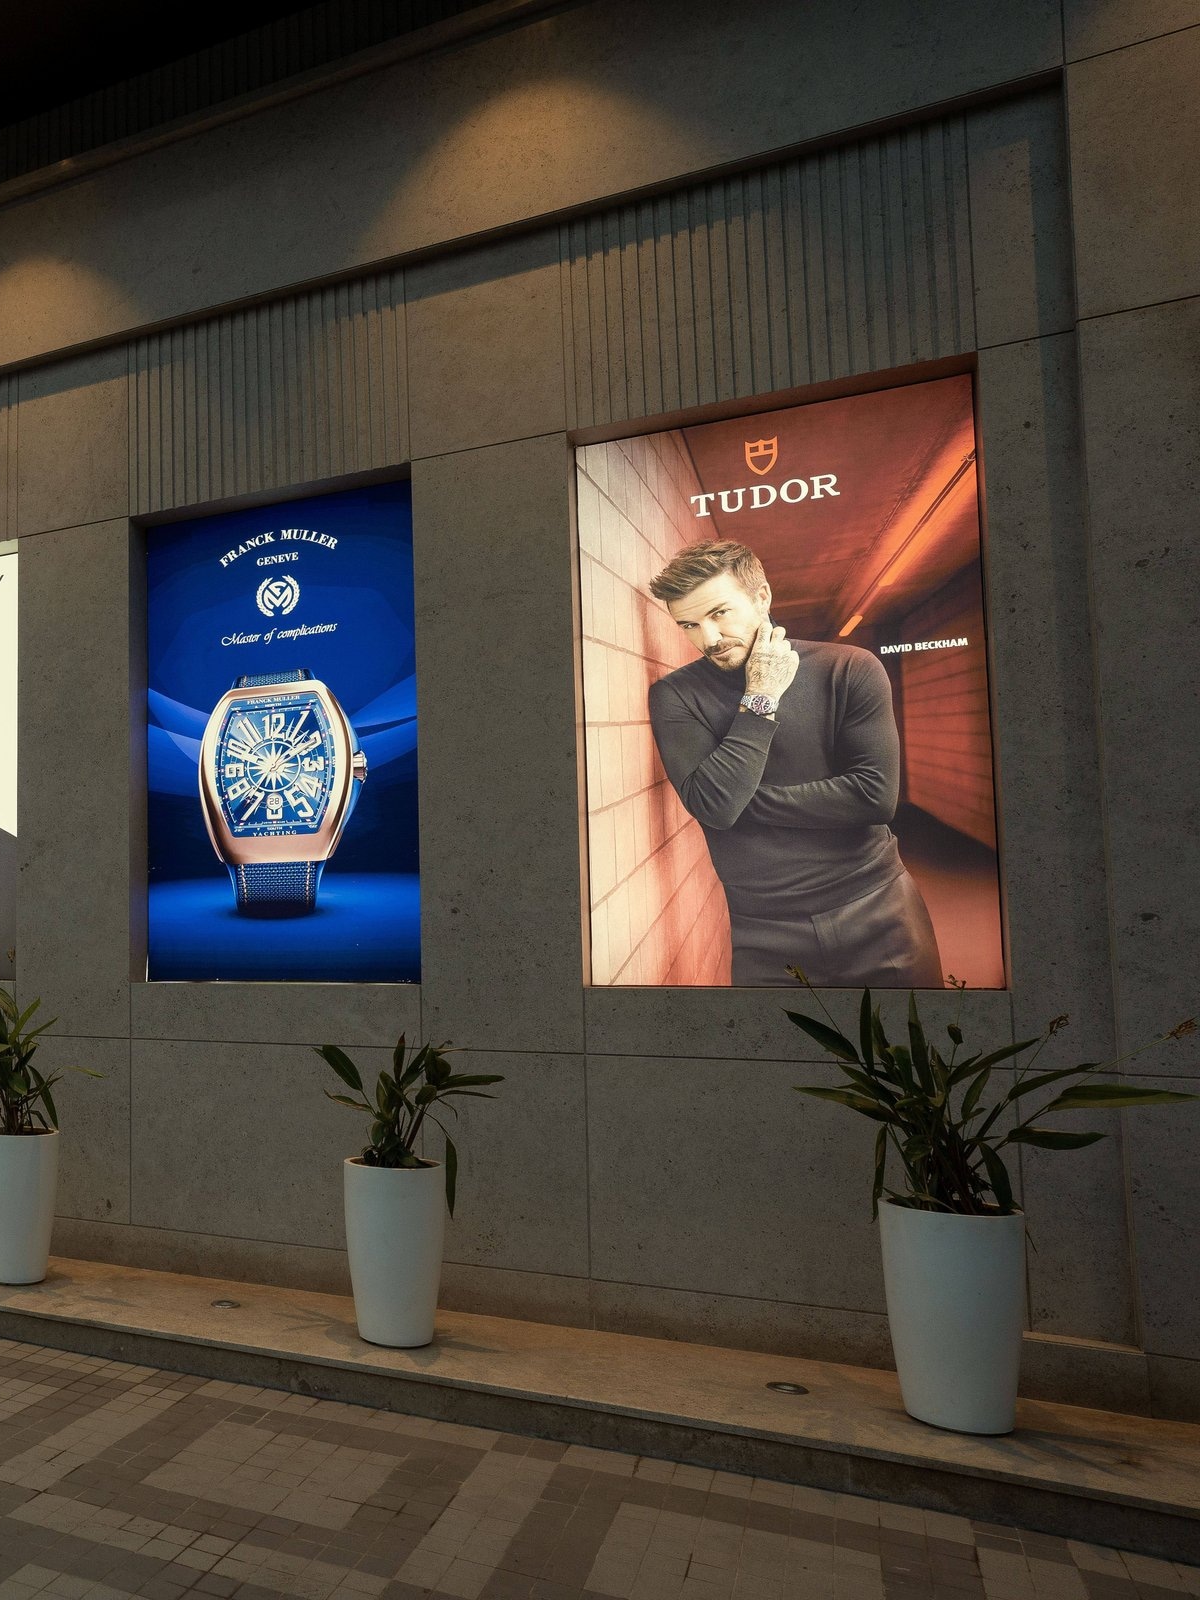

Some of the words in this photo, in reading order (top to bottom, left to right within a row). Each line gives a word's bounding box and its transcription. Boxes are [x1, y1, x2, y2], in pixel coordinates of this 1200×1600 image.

[690, 473, 841, 518] TUDOR
[219, 531, 276, 568] FRANCK
[280, 528, 339, 550] MULLER
[256, 551, 299, 567] GENEVE
[221, 632, 261, 647] Master
[263, 628, 278, 645] of
[277, 622, 338, 641] complications
[880, 643, 913, 655] DAVID
[914, 637, 969, 652] BECKHAM
[246, 698, 273, 706] FRANCK
[272, 695, 301, 703] MULLER
[261, 712, 286, 740] 12
[269, 797, 280, 805] 28
